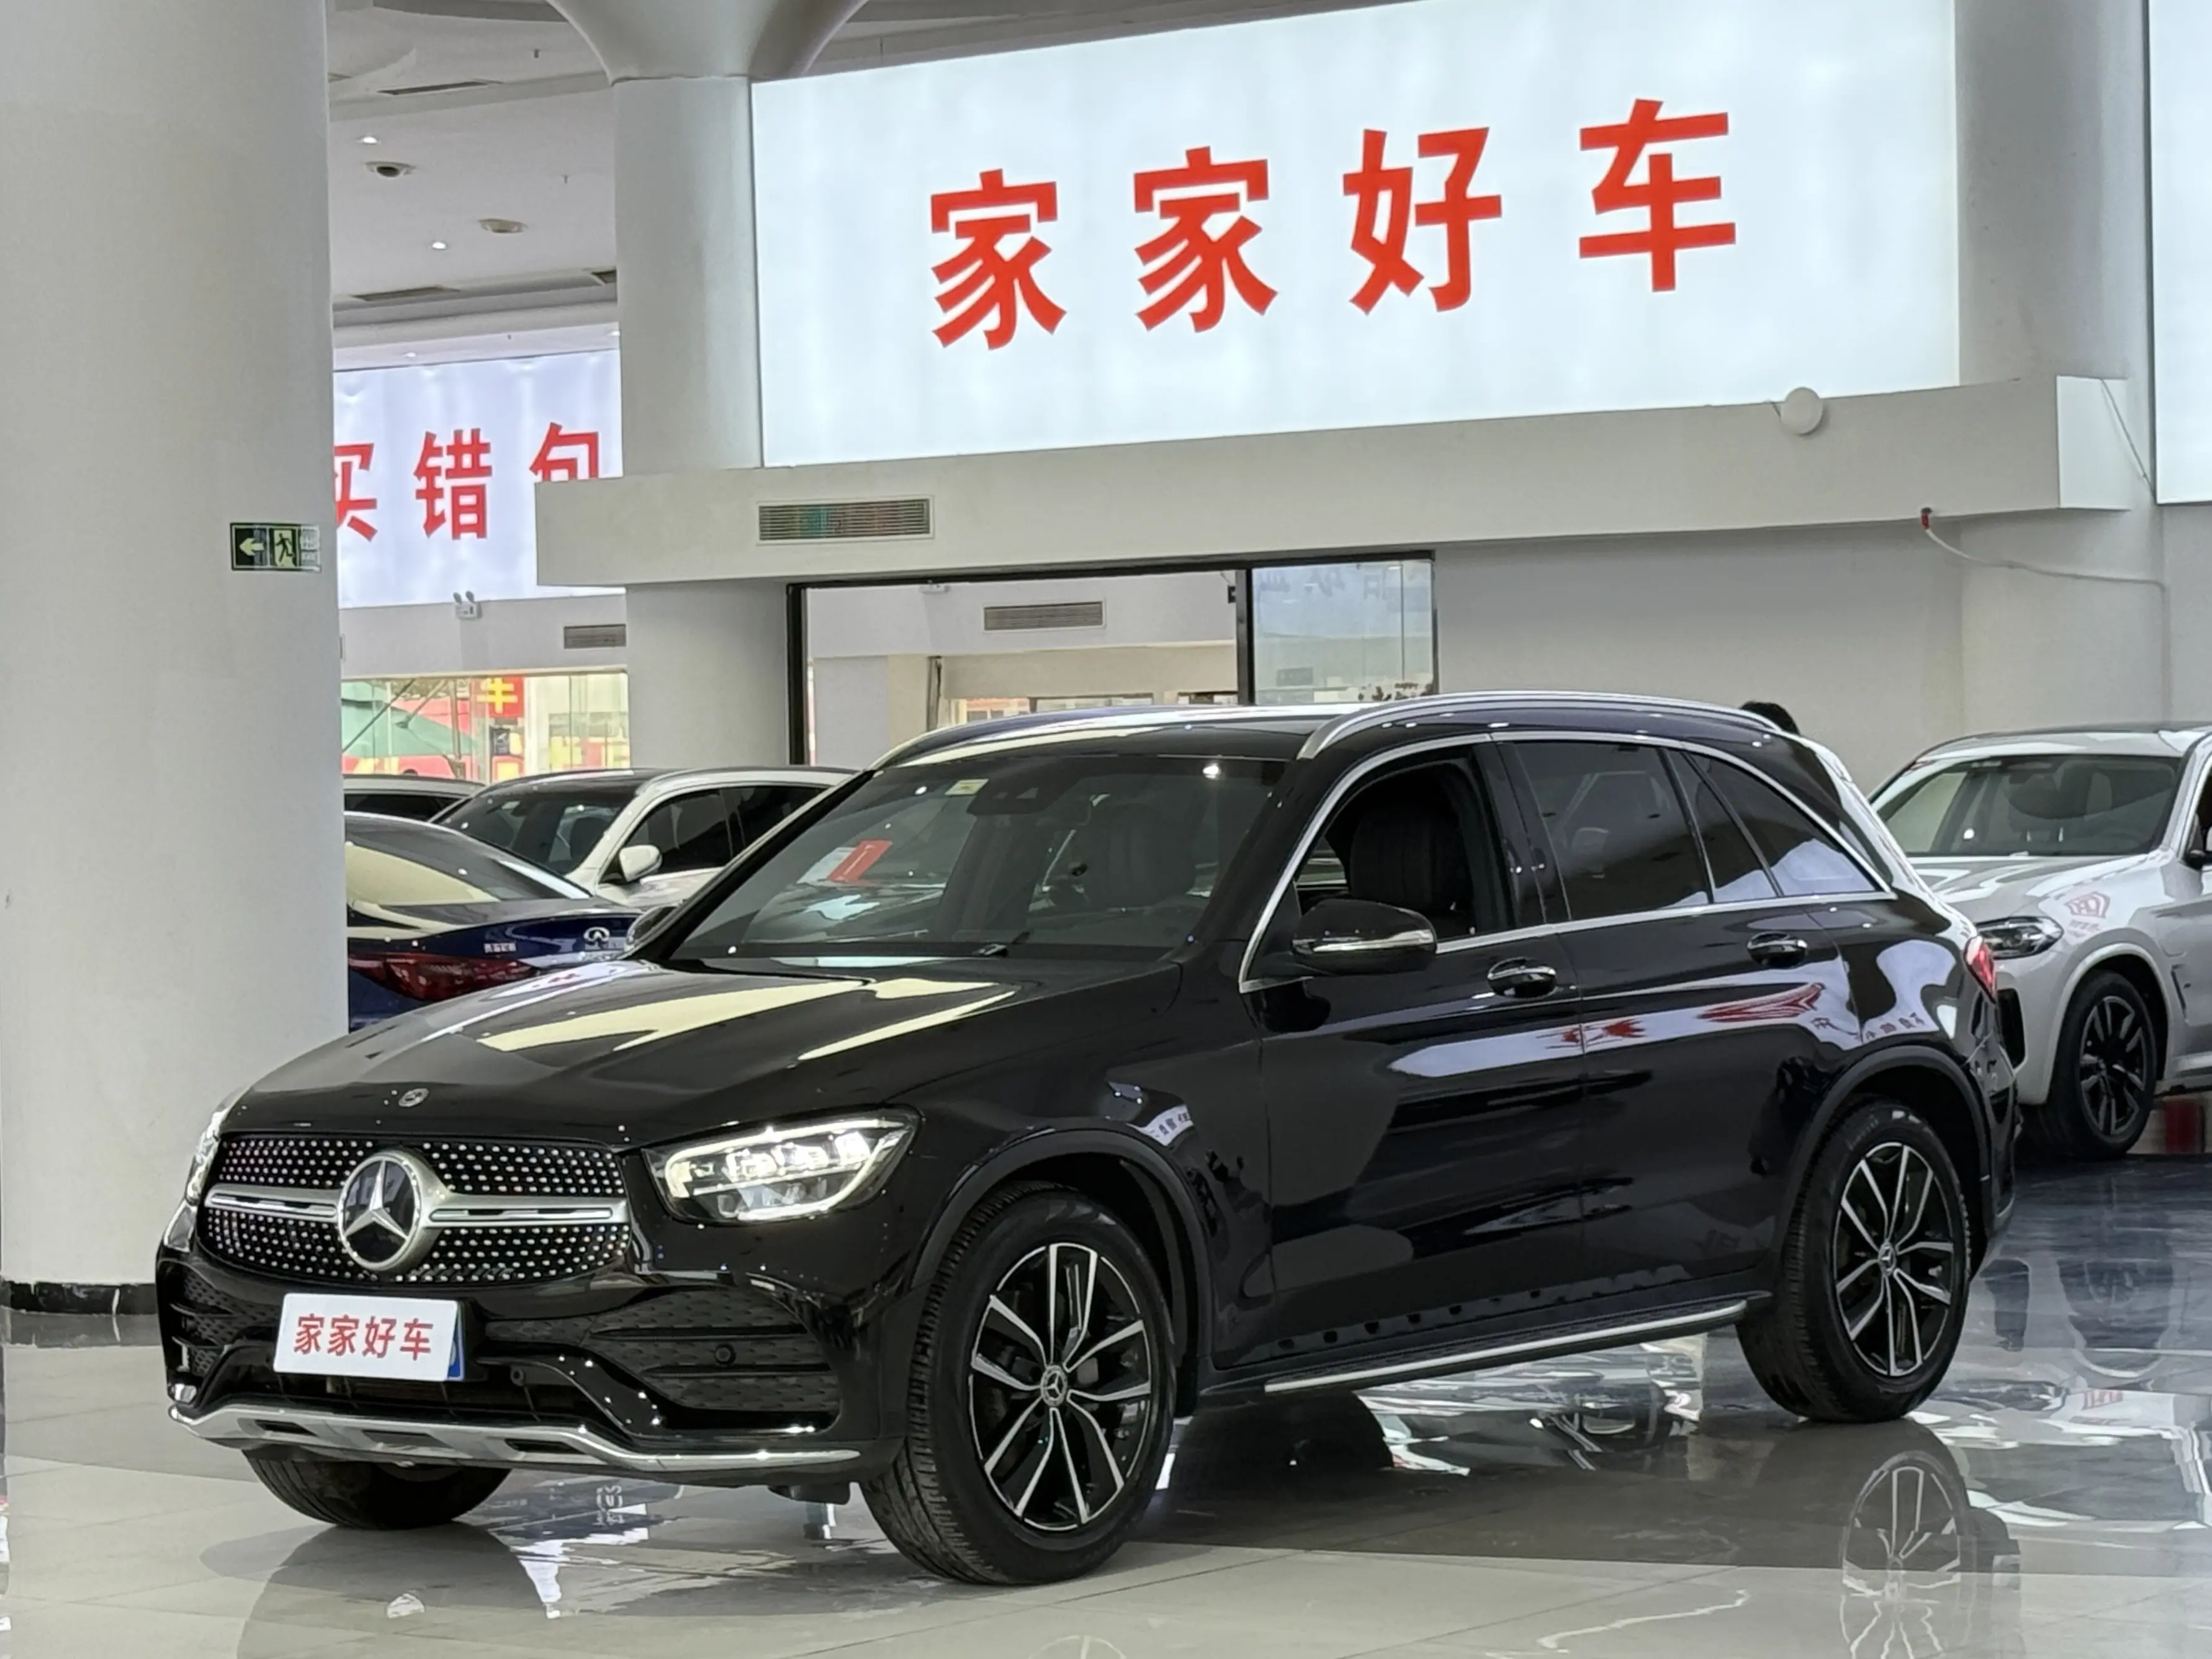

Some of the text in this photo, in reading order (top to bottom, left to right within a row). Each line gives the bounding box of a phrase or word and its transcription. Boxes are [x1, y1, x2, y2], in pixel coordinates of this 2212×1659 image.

[930, 98, 1737, 349] 家家好车
[294, 1313, 434, 1361] 家家好车
